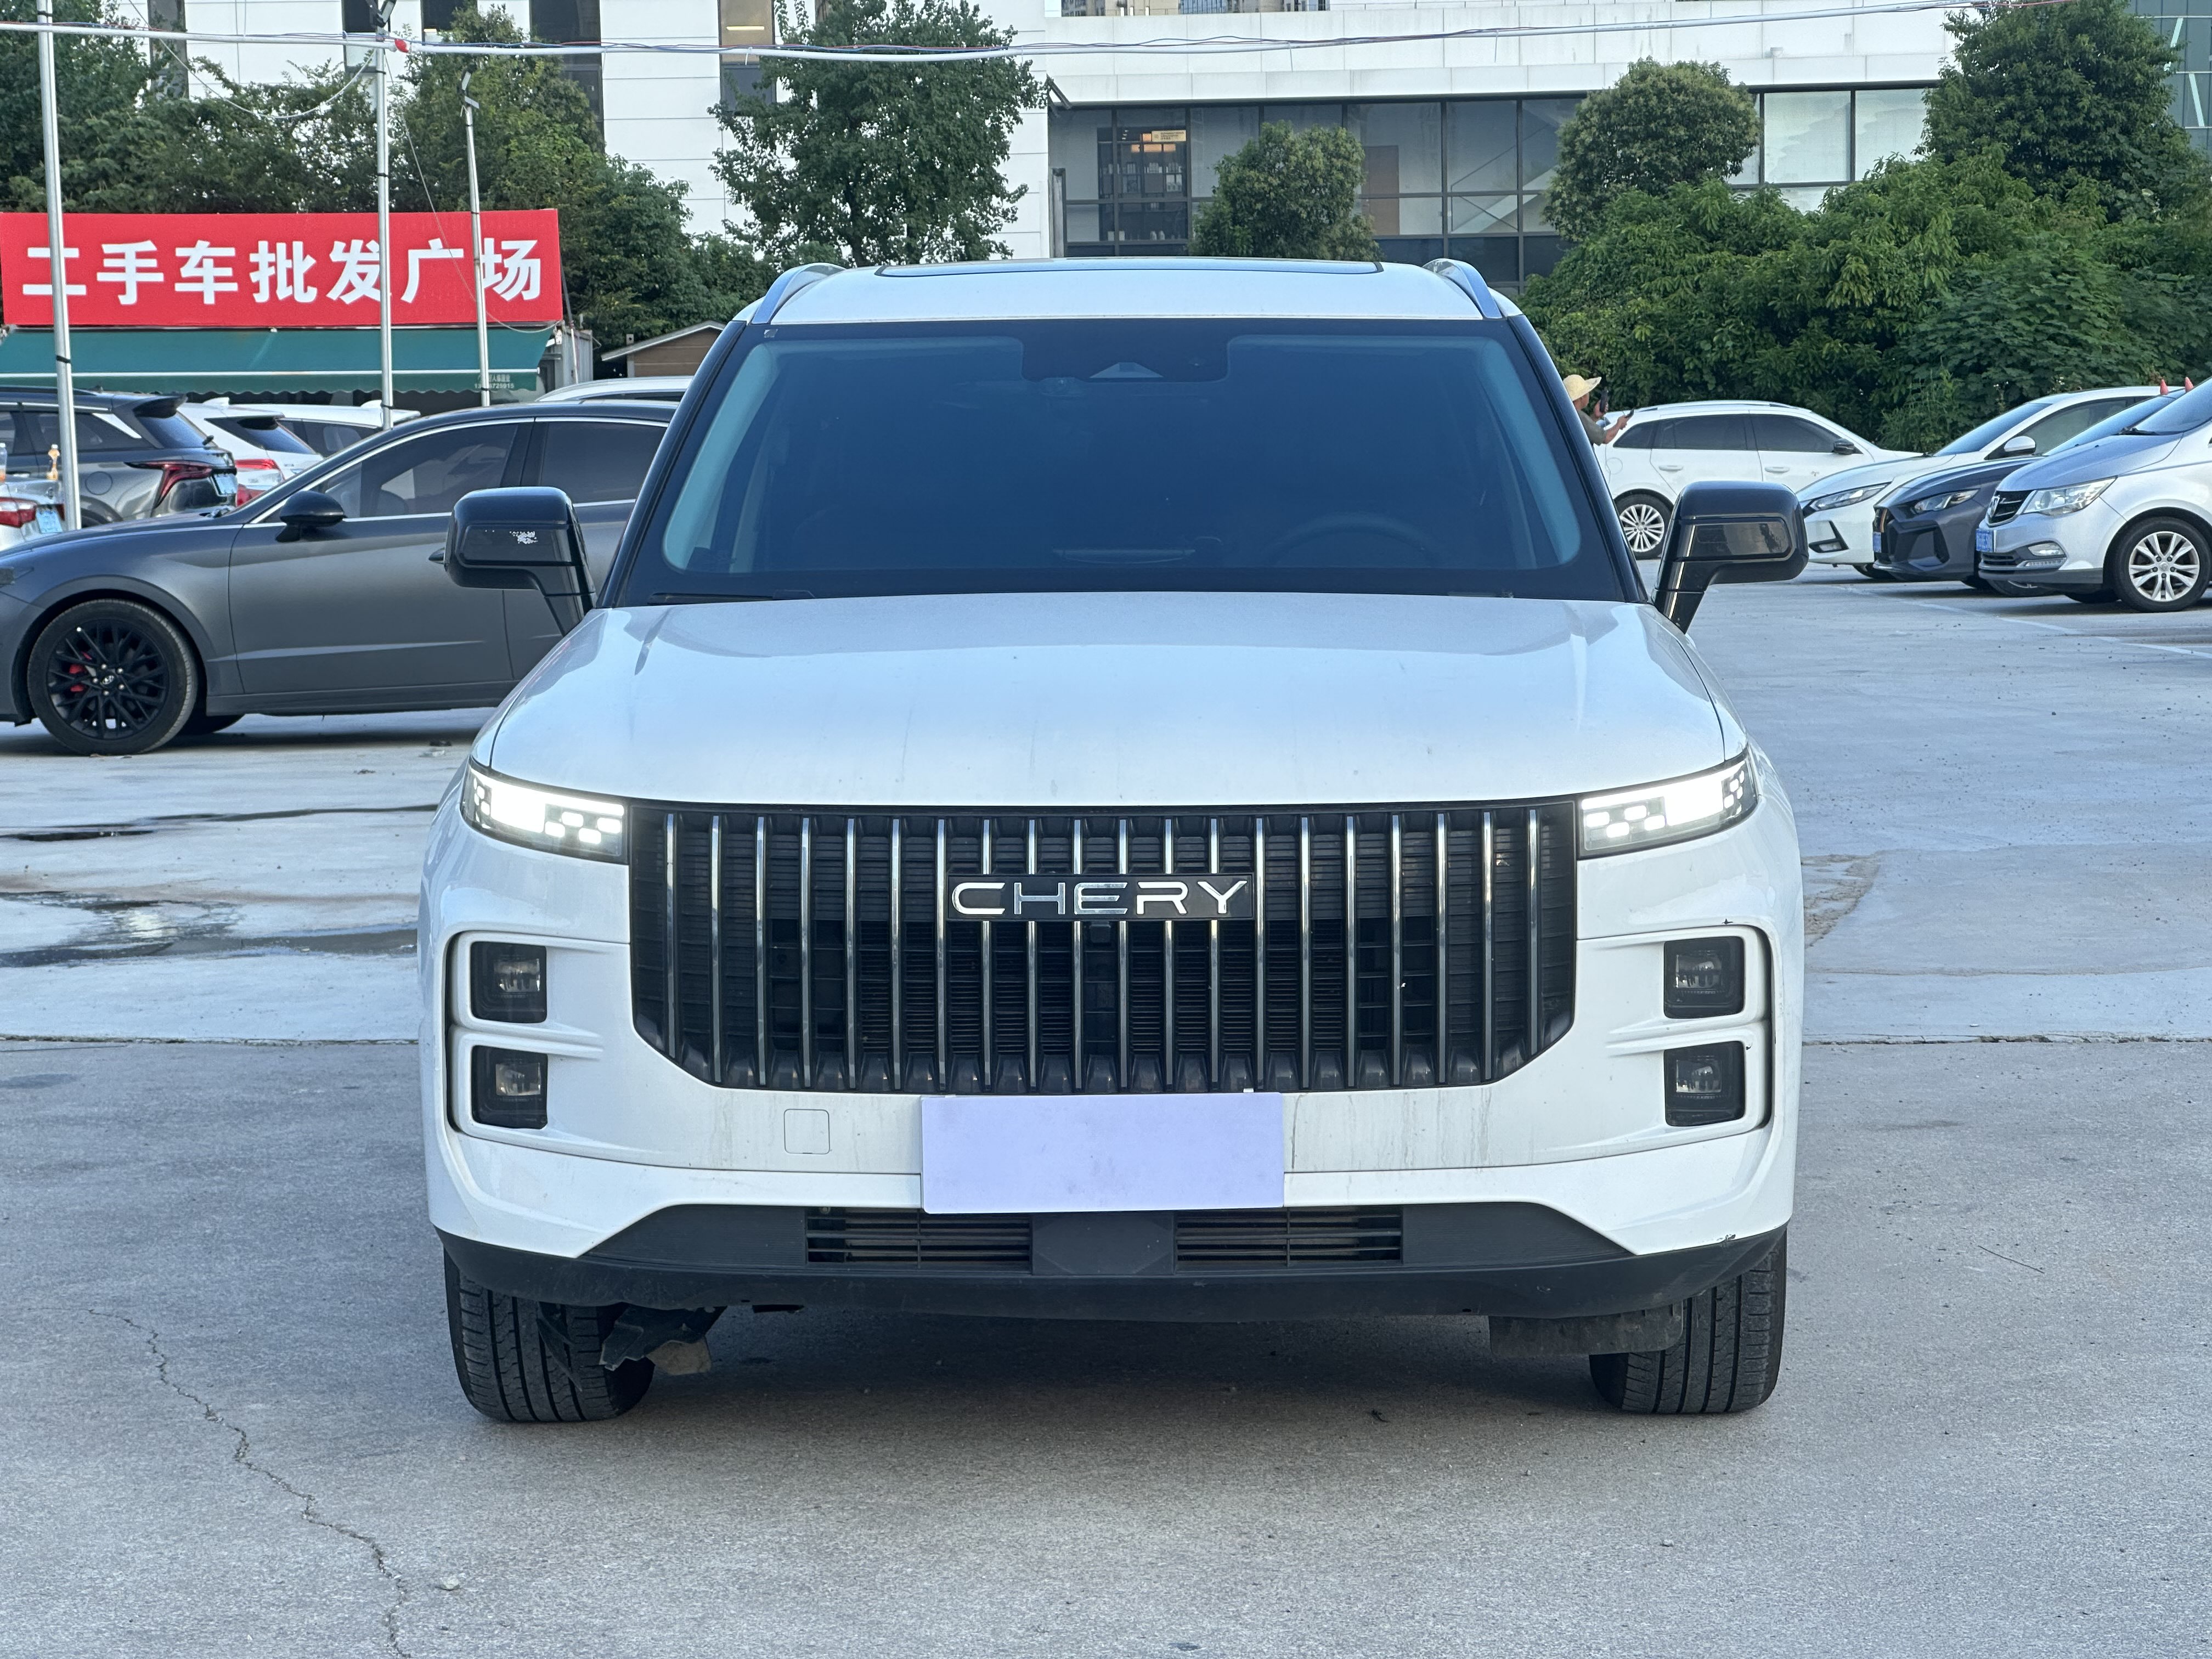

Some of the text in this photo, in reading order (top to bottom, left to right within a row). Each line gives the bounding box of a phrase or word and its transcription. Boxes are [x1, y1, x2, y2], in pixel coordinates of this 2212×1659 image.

[22, 238, 541, 305] 二手车批发广场
[951, 880, 1248, 915] CHERY
